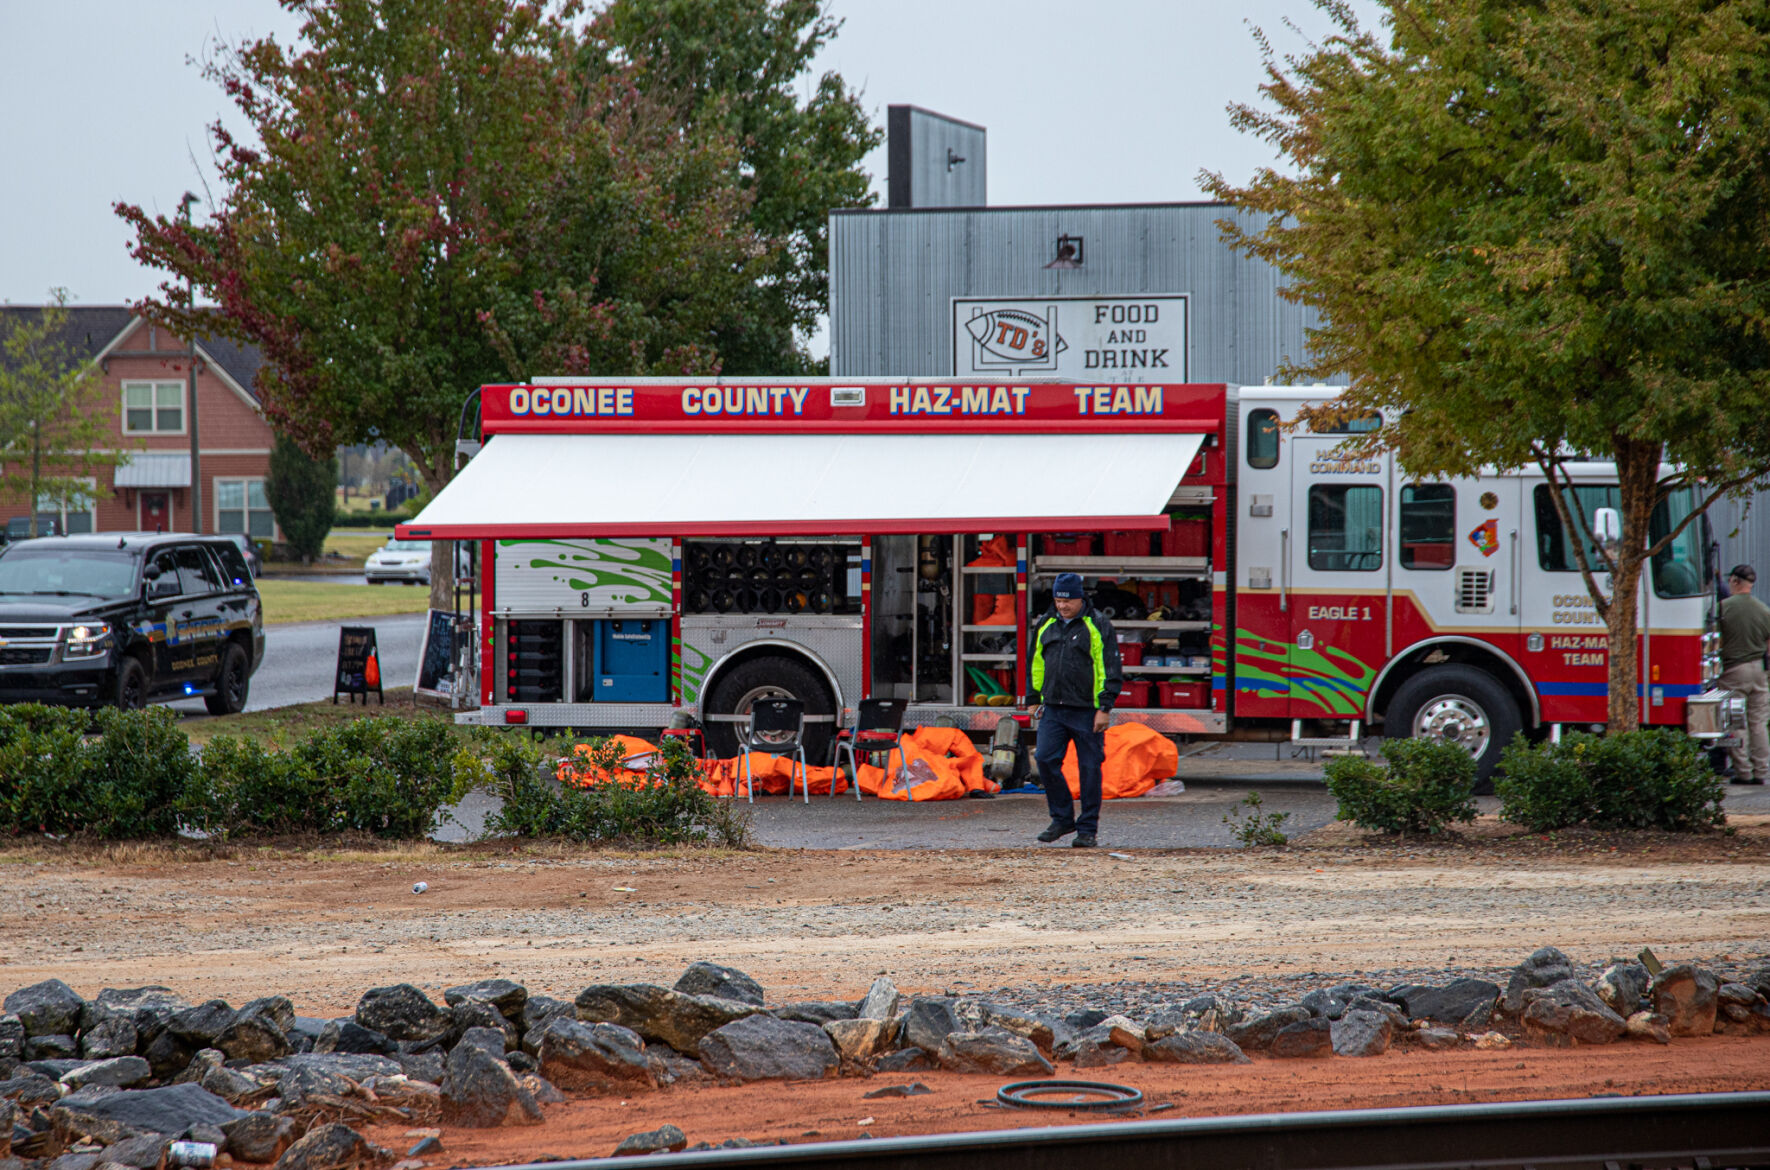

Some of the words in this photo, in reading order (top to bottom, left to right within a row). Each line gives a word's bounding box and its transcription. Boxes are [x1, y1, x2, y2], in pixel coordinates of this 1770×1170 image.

[1094, 304, 1159, 324] FOOD
[996, 320, 1046, 357] TD's
[1107, 329, 1146, 344] AND
[1084, 349, 1169, 369] DRINK
[509, 387, 635, 416] OCONEE
[681, 387, 809, 416] COUNTY
[889, 386, 1031, 416] HAZ-MAT
[1074, 386, 1164, 416] TEAM
[1310, 461, 1381, 475] COMMAND
[581, 591, 589, 608] 8
[1552, 593, 1613, 608] OCONE
[1308, 605, 1358, 621] EAGLE
[1361, 606, 1372, 621] 1
[1552, 610, 1601, 624] COUNT
[1551, 636, 1609, 650] HAZ-MA
[1562, 653, 1604, 666] TEAM
